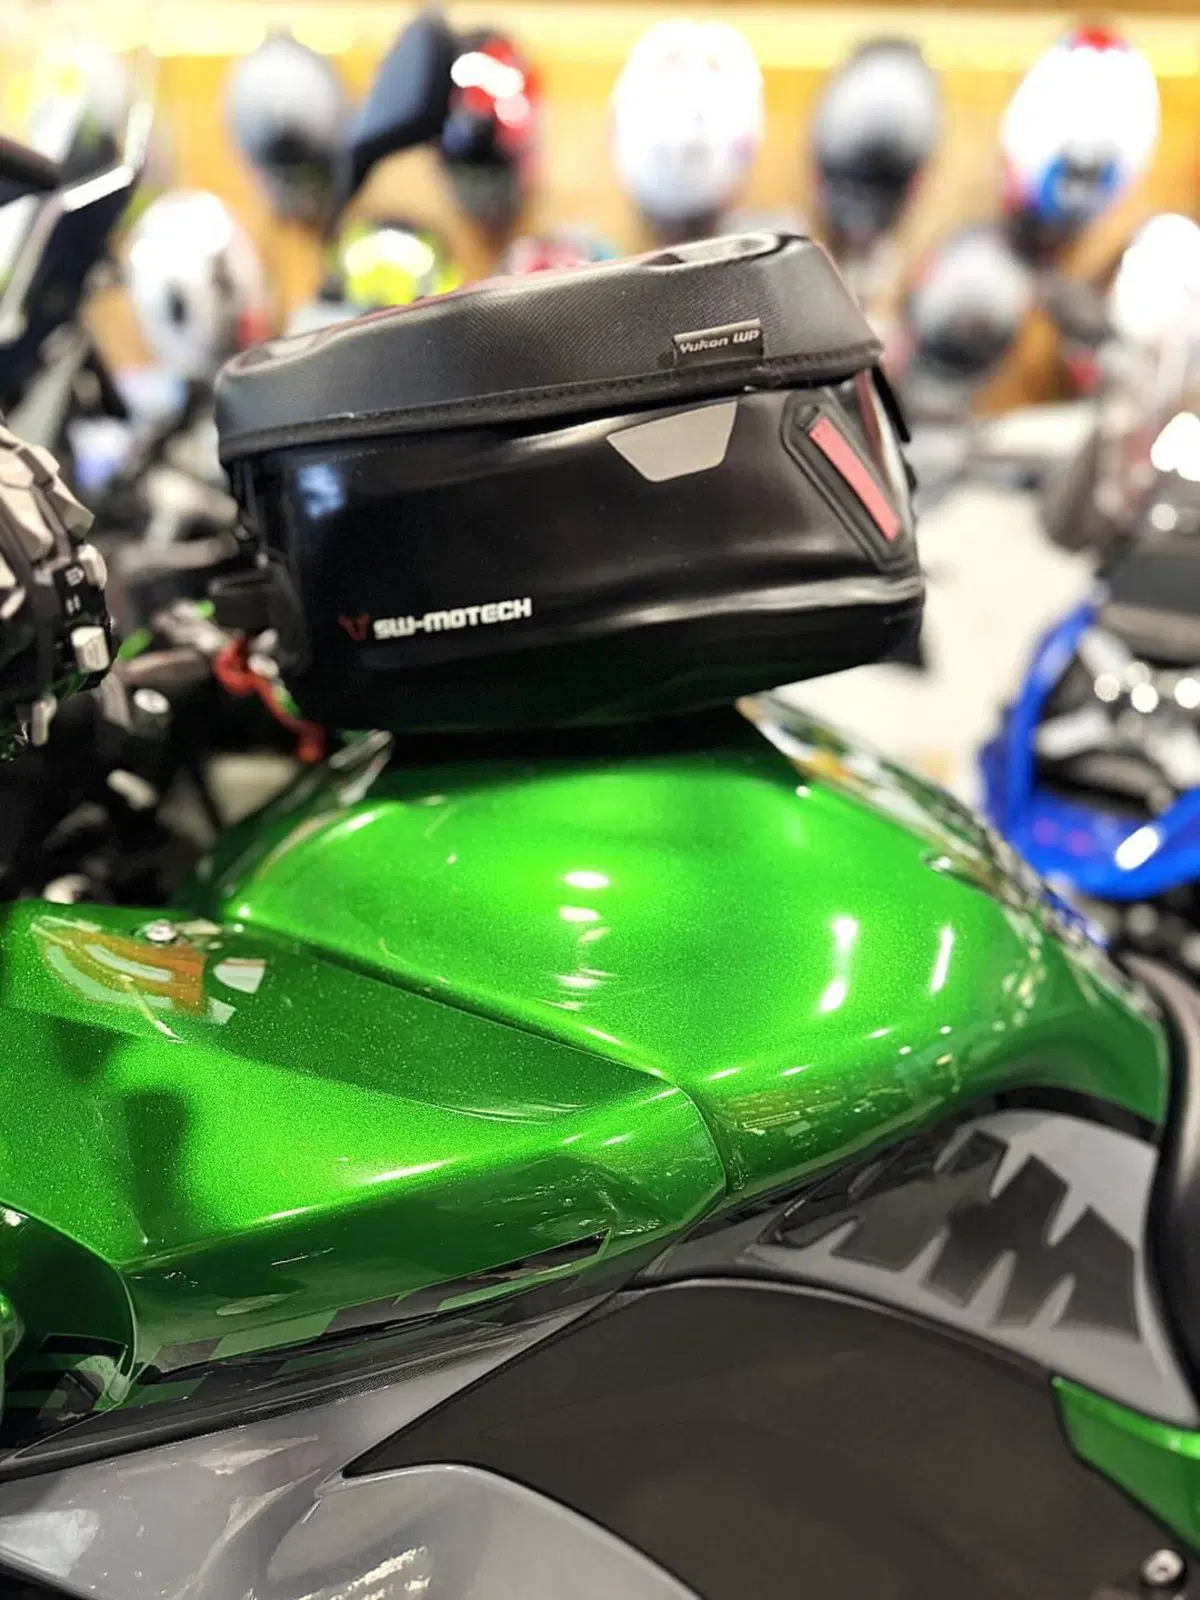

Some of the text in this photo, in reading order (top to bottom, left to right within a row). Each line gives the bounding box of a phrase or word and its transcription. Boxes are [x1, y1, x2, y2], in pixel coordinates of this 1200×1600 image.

[680, 329, 760, 353] Yukon WP
[373, 597, 532, 640] SW-MOTECH
